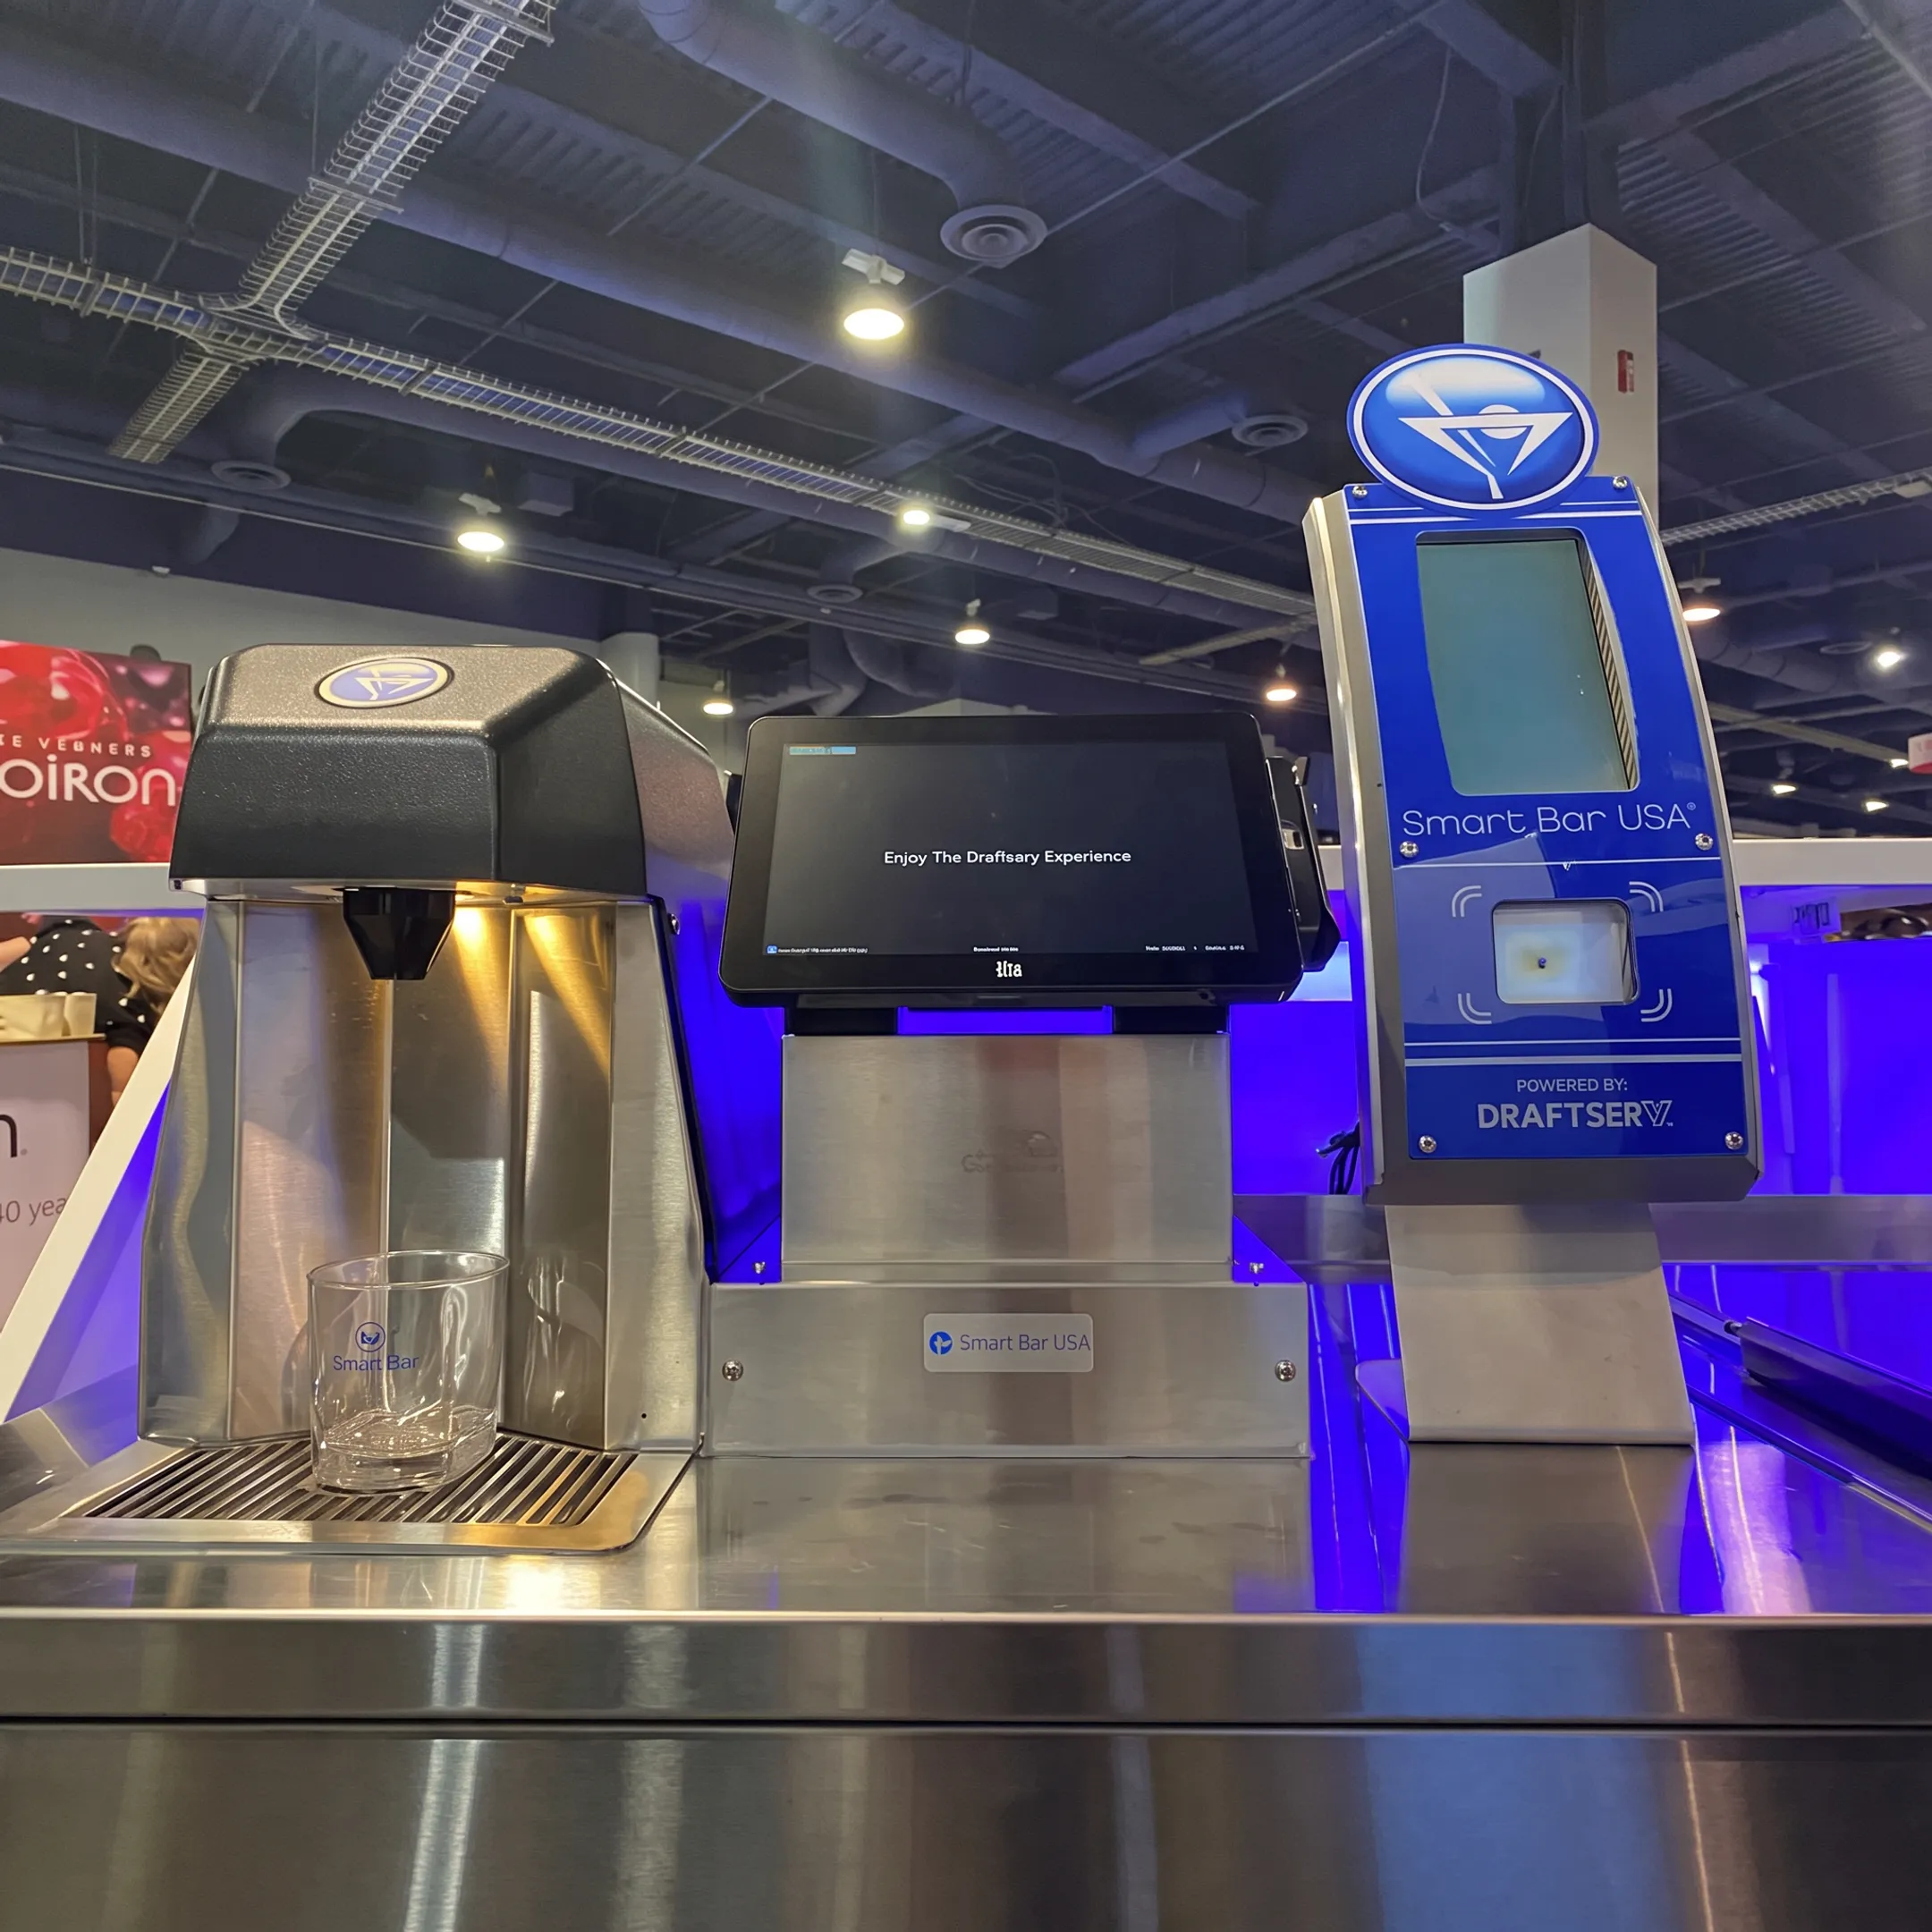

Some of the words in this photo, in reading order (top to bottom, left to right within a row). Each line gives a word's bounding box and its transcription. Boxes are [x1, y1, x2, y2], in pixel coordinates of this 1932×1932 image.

[1402, 809, 1526, 836] Smart
[1537, 806, 1607, 834] Bar
[884, 851, 928, 867] Enjoy
[932, 851, 962, 864] The
[1044, 850, 1131, 866] Experience
[1516, 1079, 1599, 1092] POWERED
[1603, 1078, 1628, 1091] BY:
[1477, 1100, 1673, 1129] DRAFTSERV
[959, 1334, 1013, 1352] Smart
[1018, 1334, 1049, 1351] Bar
[1053, 1334, 1091, 1351] USA
[333, 1355, 383, 1371] Smart
[386, 1354, 419, 1370] Bar
